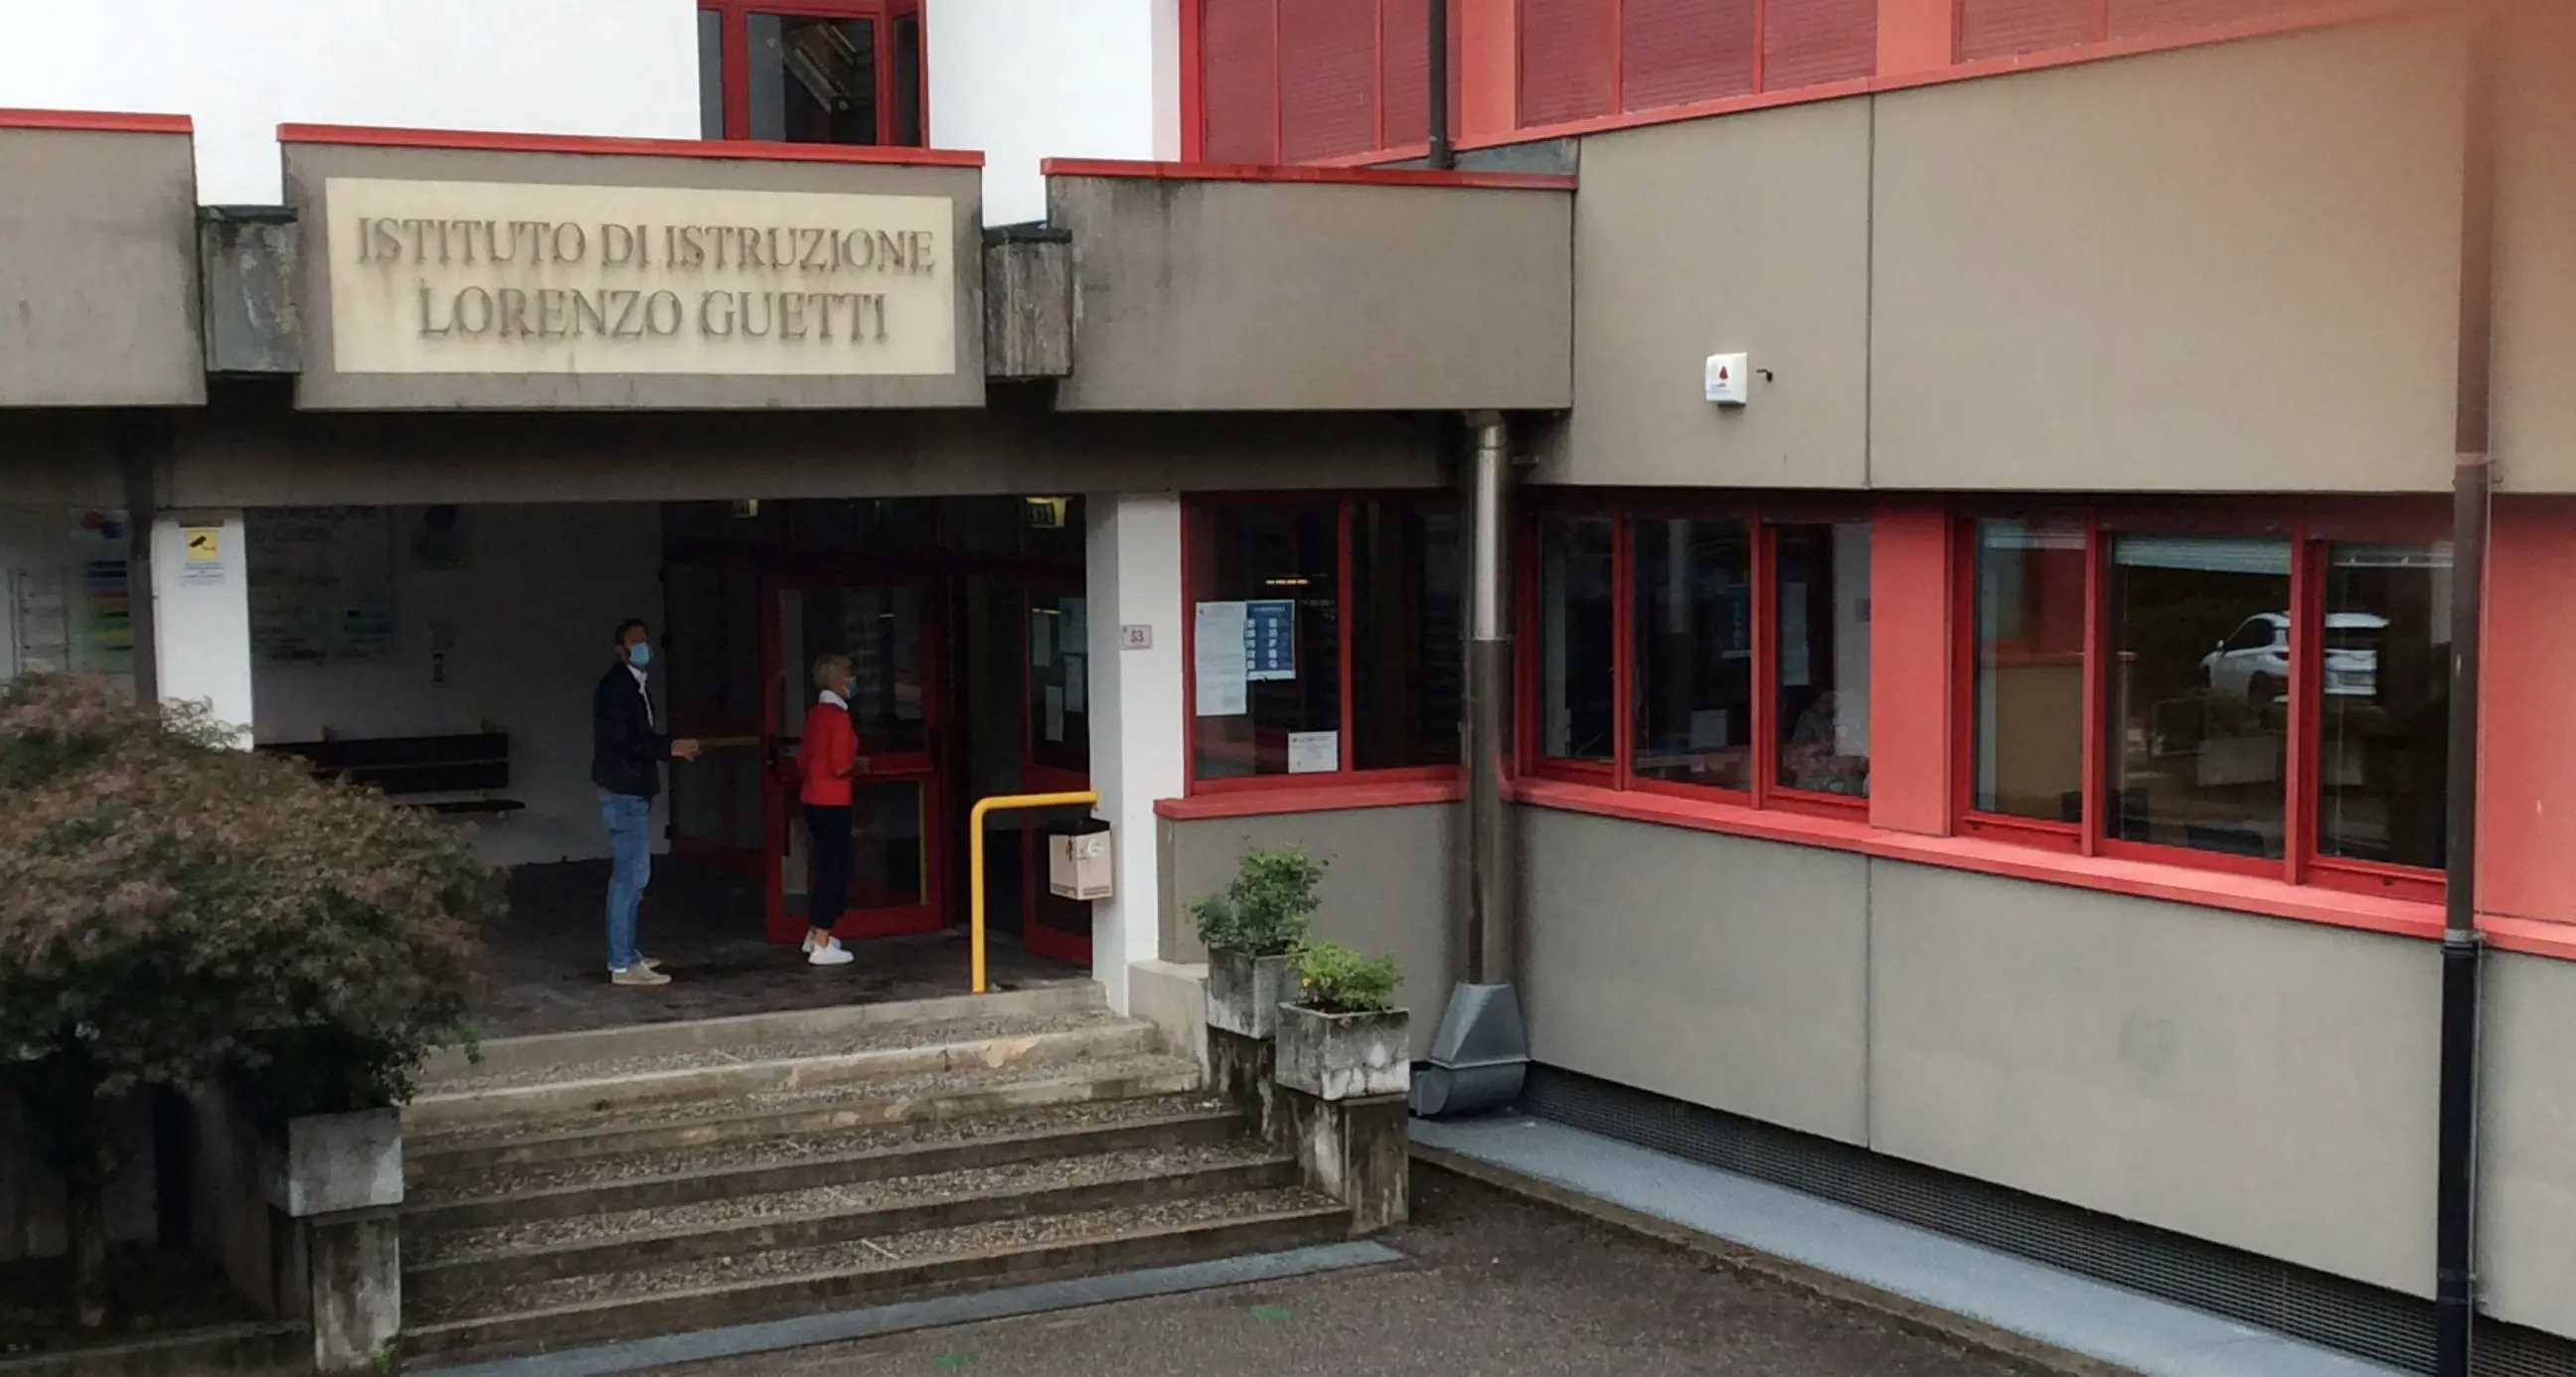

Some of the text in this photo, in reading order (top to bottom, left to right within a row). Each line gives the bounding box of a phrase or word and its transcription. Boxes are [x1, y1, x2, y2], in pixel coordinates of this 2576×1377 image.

[358, 217, 935, 272] ISTITUTO DI ISTRUZIONE
[417, 285, 888, 341] LORENZO GUETTI
